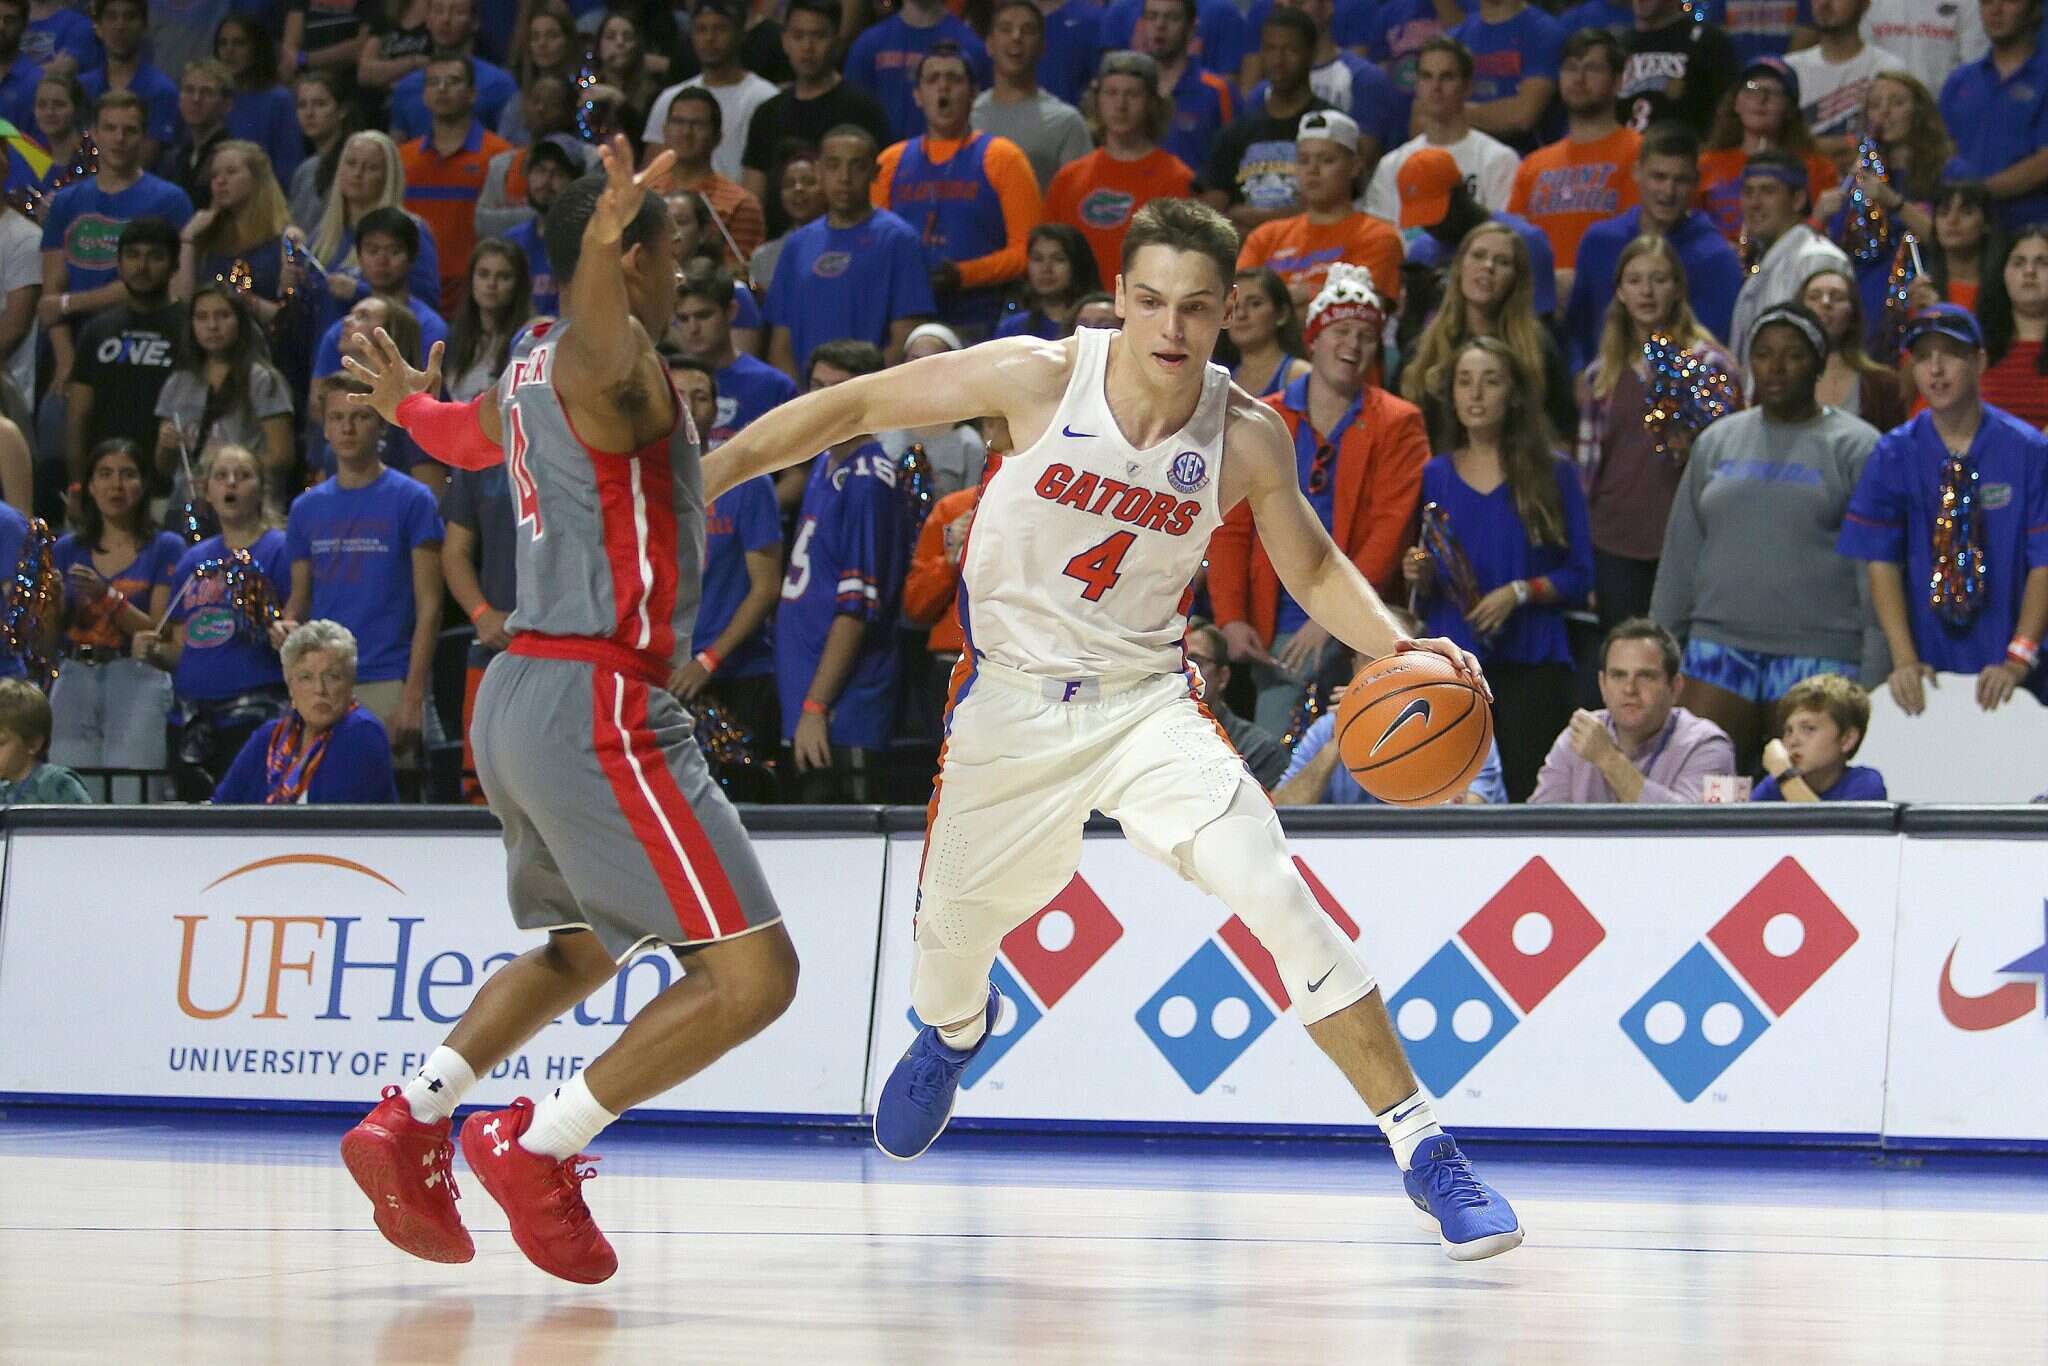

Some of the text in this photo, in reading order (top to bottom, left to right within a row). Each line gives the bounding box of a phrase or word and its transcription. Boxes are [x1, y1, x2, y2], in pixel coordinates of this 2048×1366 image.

[1175, 453, 1203, 483] SEC
[1034, 462, 1202, 536] GATORS
[1062, 530, 1138, 602] 4
[1061, 681, 1082, 703] F
[169, 1047, 343, 1075] UNIVERSITY
[350, 1051, 388, 1076] OF
